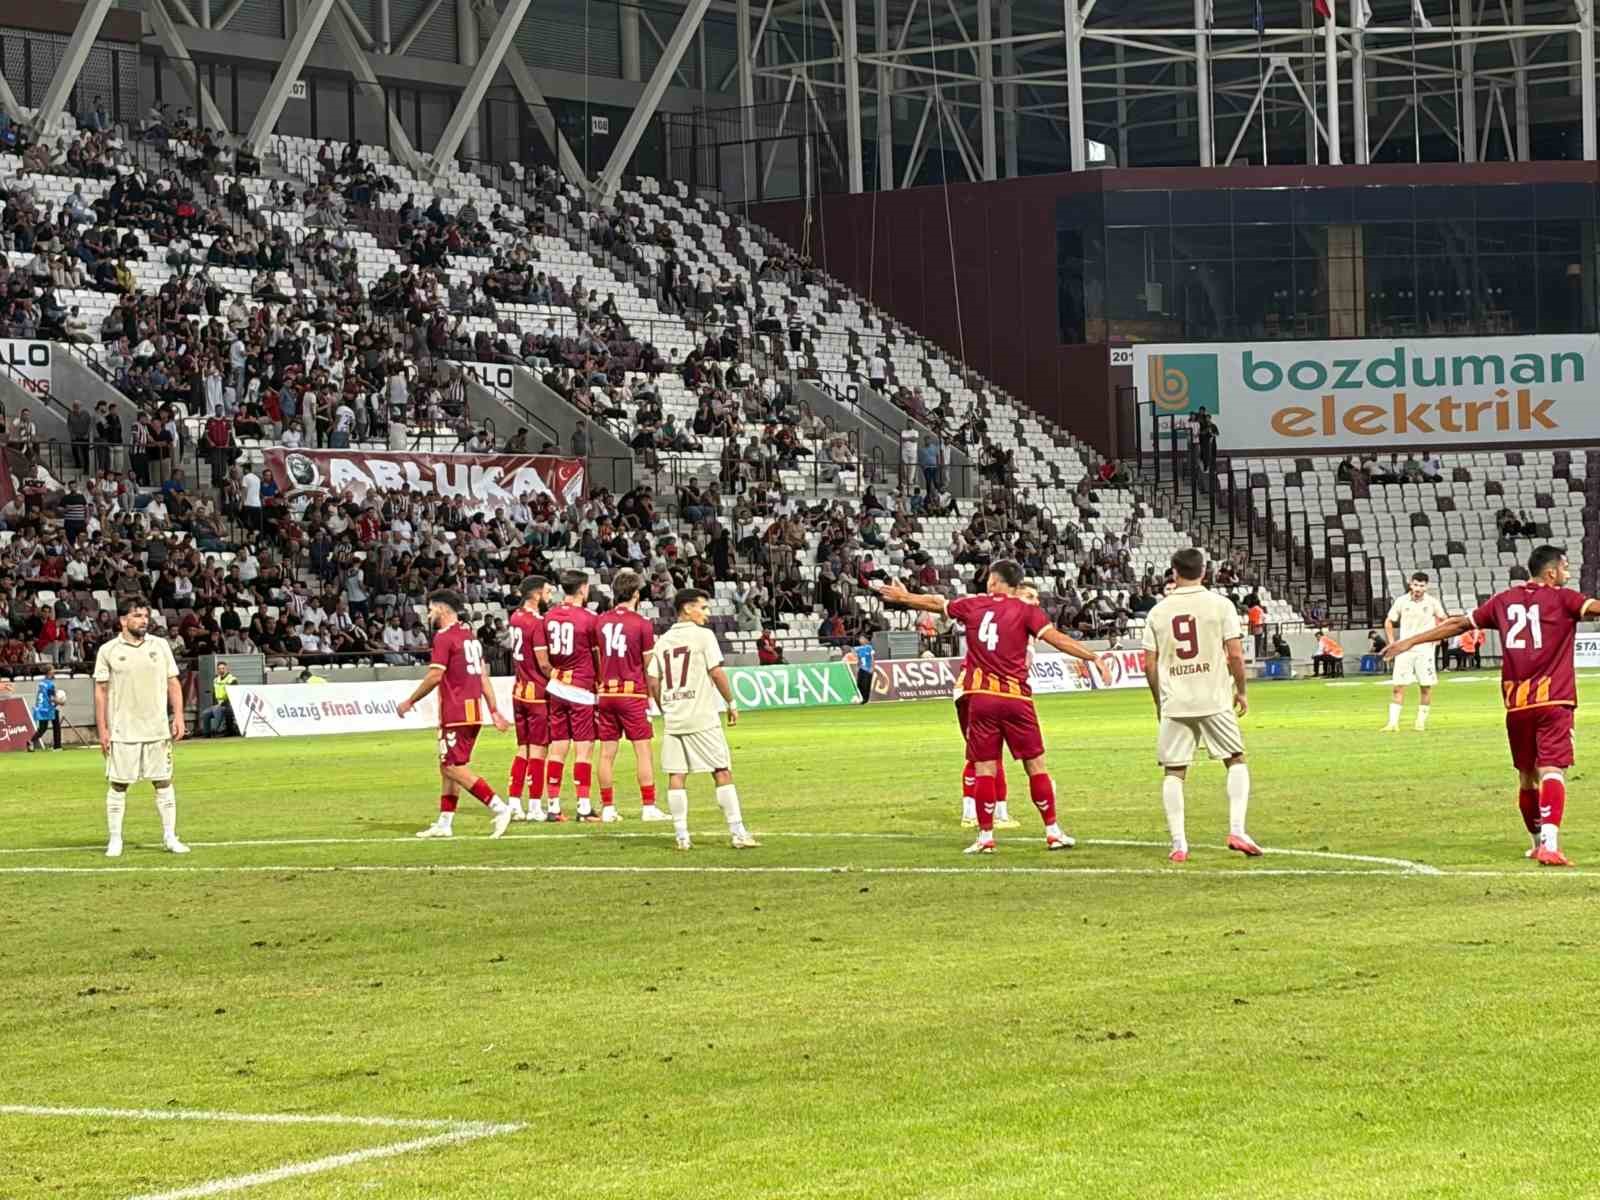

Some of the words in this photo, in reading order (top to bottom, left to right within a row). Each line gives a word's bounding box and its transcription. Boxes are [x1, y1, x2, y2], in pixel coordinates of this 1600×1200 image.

[289, 83, 305, 95] 07
[0, 343, 49, 367] LO
[1242, 347, 1584, 392] bozduman
[1271, 389, 1559, 437] elektrik
[329, 458, 556, 503] ABLUKA
[547, 621, 574, 656] 39
[602, 623, 627, 657] 14
[978, 611, 999, 651] 4
[1171, 614, 1199, 660] 9
[1506, 604, 1543, 649] 21
[663, 646, 690, 690] 17
[732, 667, 841, 706] ORZAX
[892, 660, 956, 687] ASSA
[321, 700, 362, 717] final
